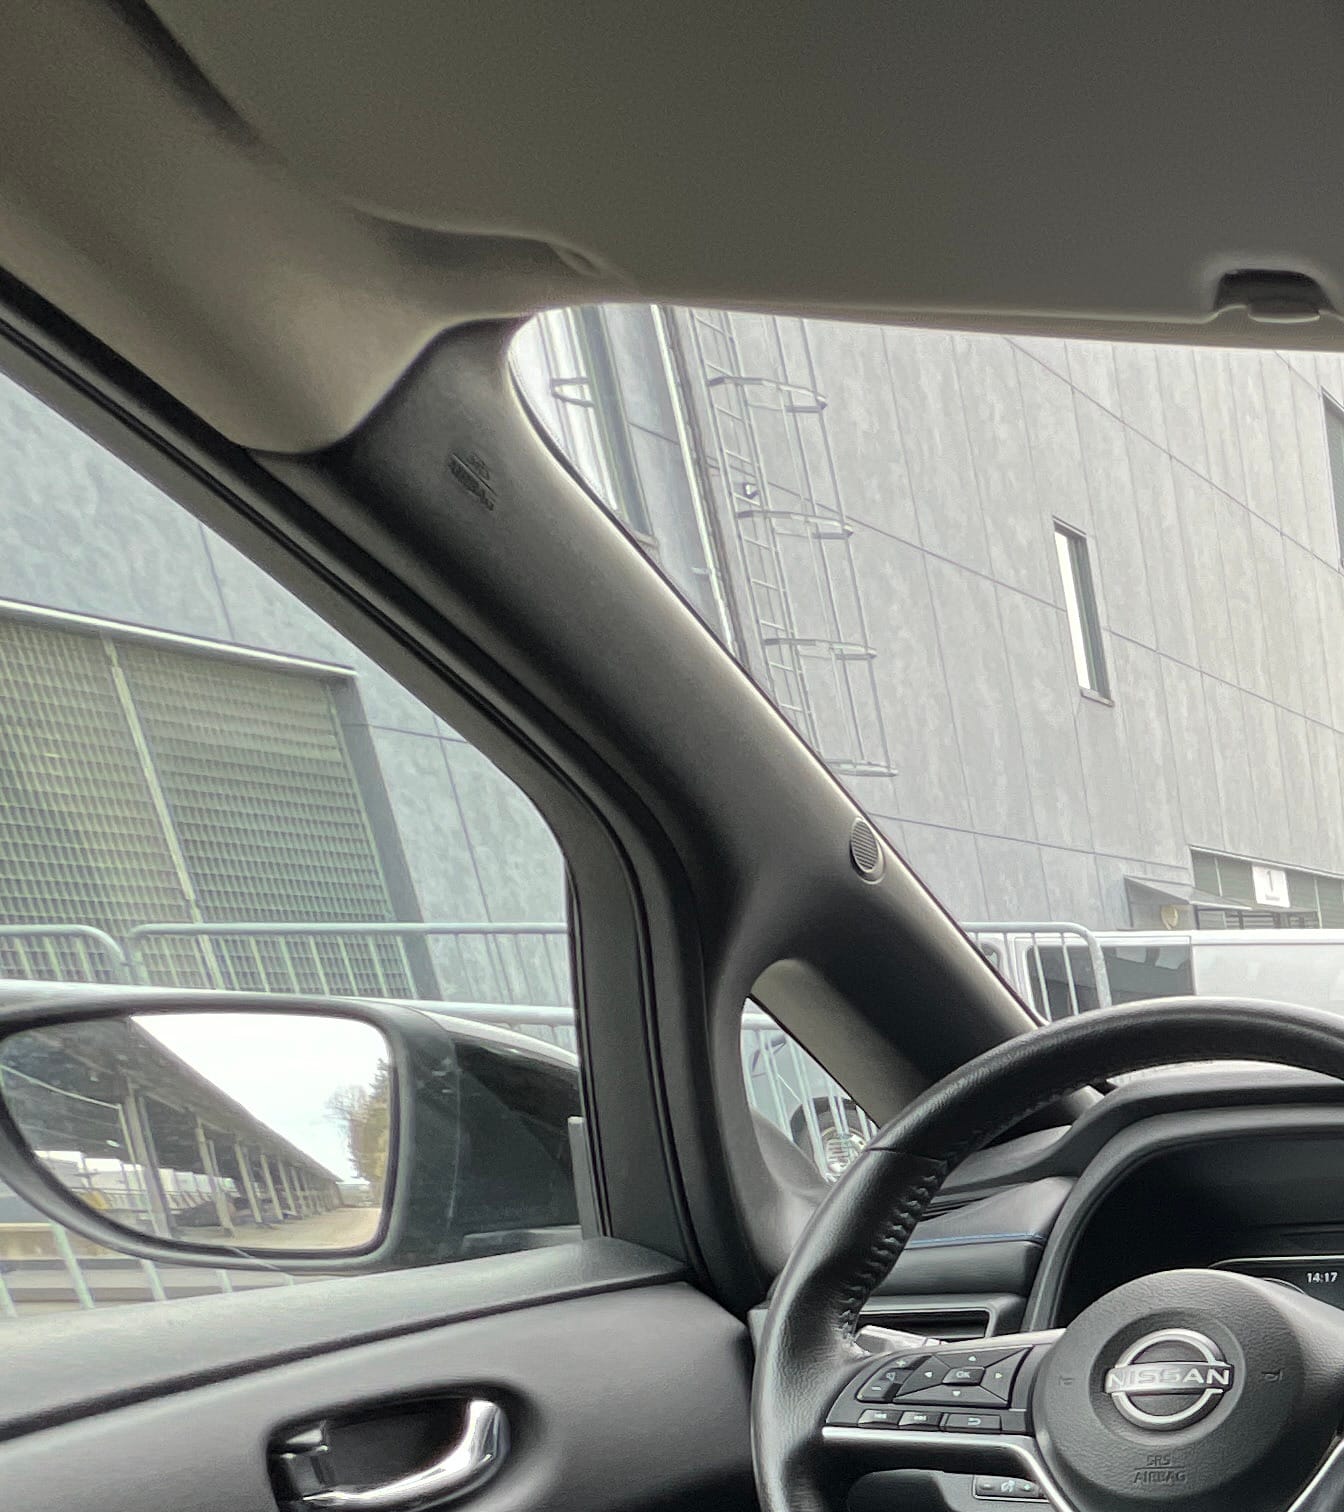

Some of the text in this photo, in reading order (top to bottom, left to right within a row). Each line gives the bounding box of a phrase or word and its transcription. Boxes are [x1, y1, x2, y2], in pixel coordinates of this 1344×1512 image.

[1306, 1271, 1338, 1283] 14:17
[955, 1370, 971, 1379] OK
[1107, 1367, 1230, 1389] NISSAN
[1134, 1470, 1186, 1483] AIRBAG
